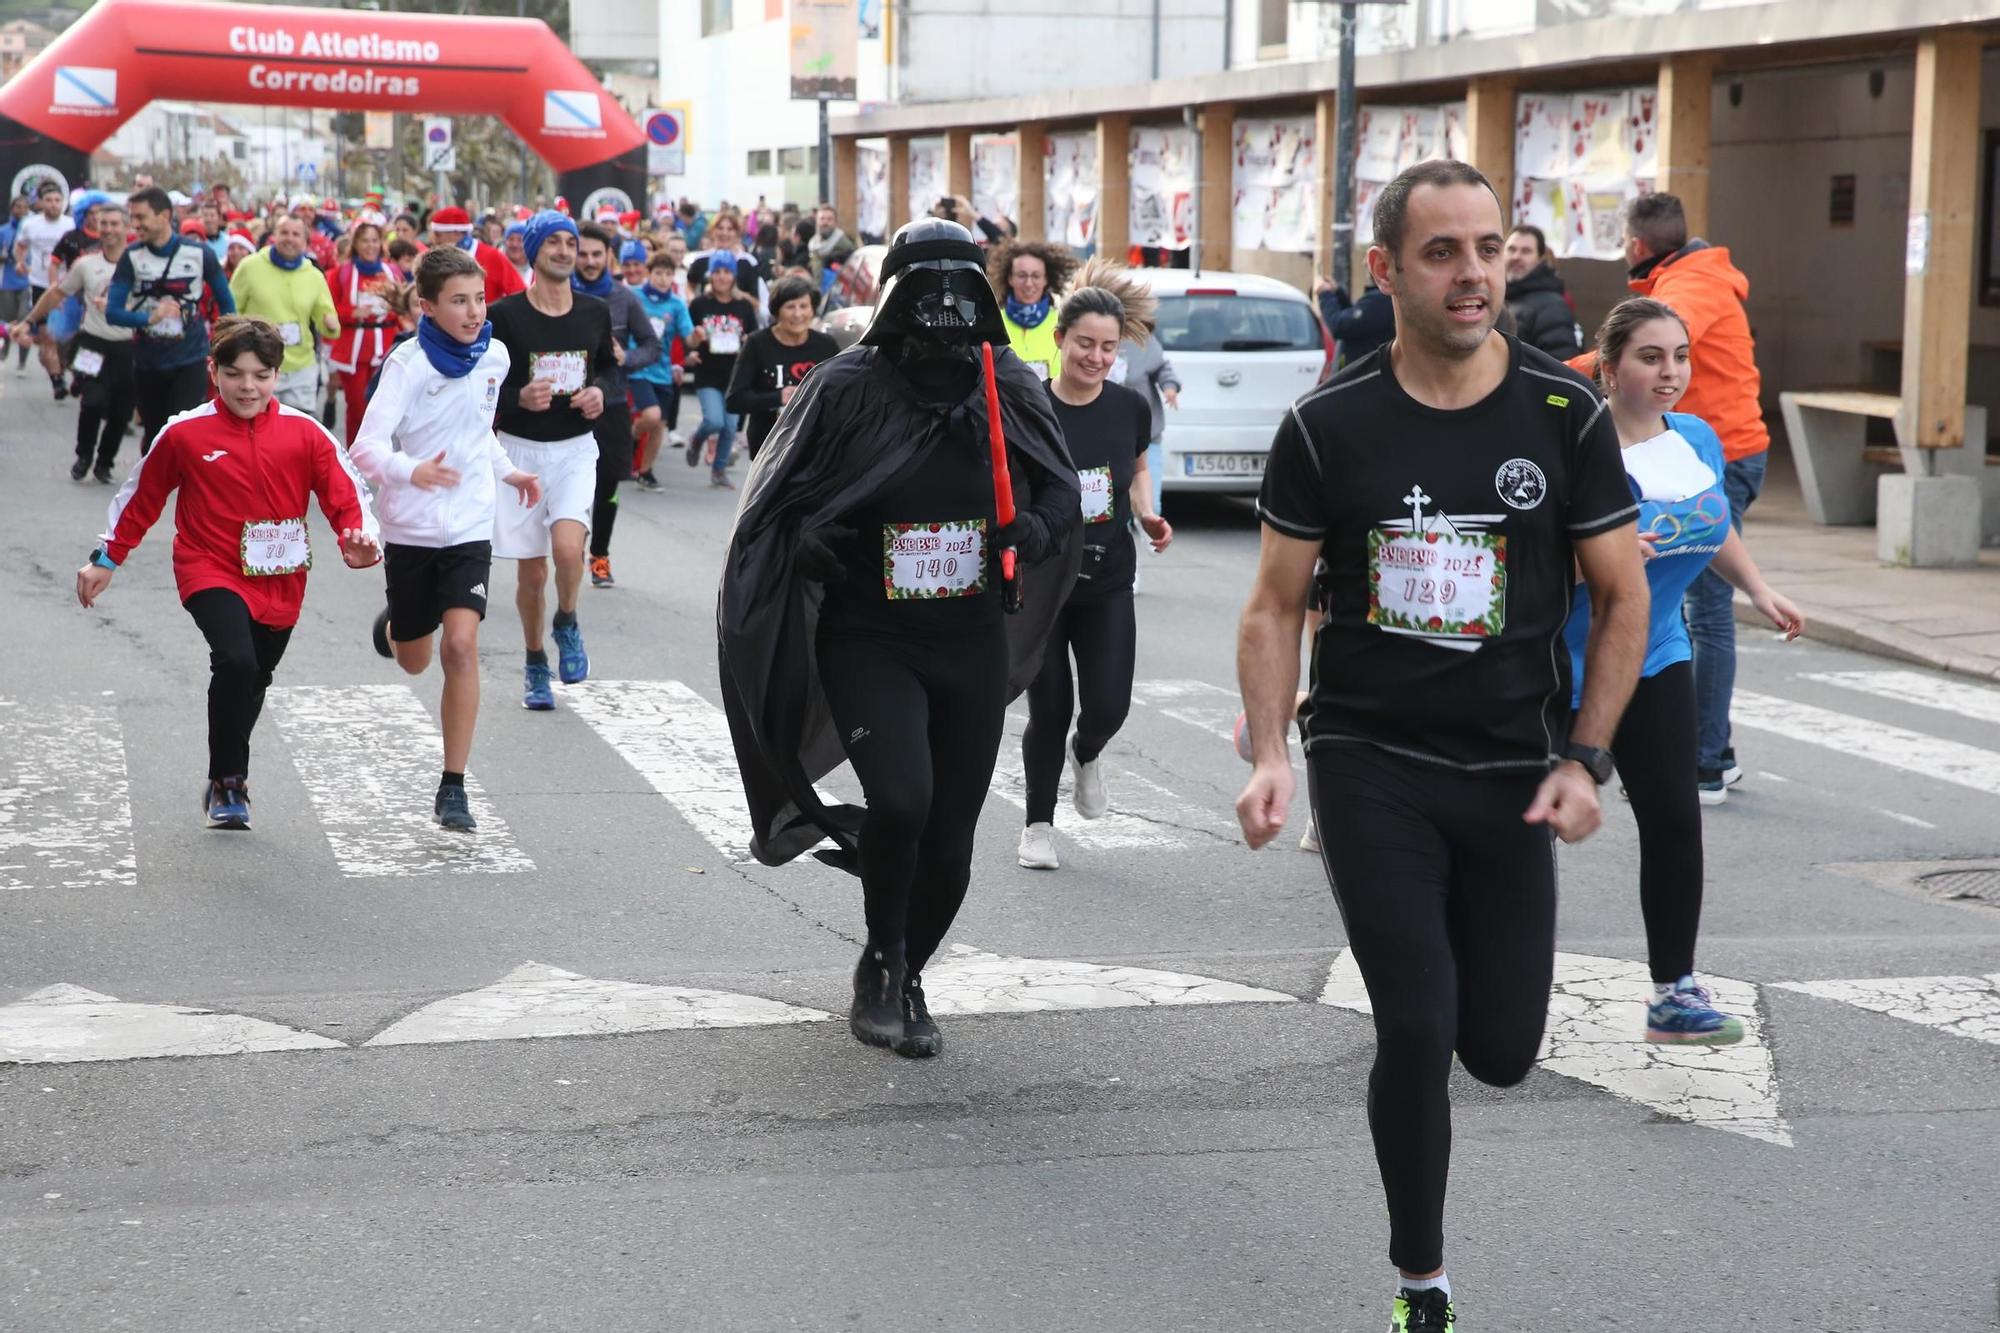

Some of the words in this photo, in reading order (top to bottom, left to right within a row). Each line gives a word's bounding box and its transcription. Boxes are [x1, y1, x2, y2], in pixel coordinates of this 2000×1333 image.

[229, 26, 294, 55] Club
[301, 31, 440, 62] Atletismo
[248, 64, 420, 96] Corredoiras
[1196, 456, 1236, 471] 4540
[266, 543, 285, 559] 70
[946, 536, 973, 552] 2023
[915, 557, 957, 579] 140
[1443, 555, 1483, 572] 2023
[1404, 578, 1456, 604] 129
